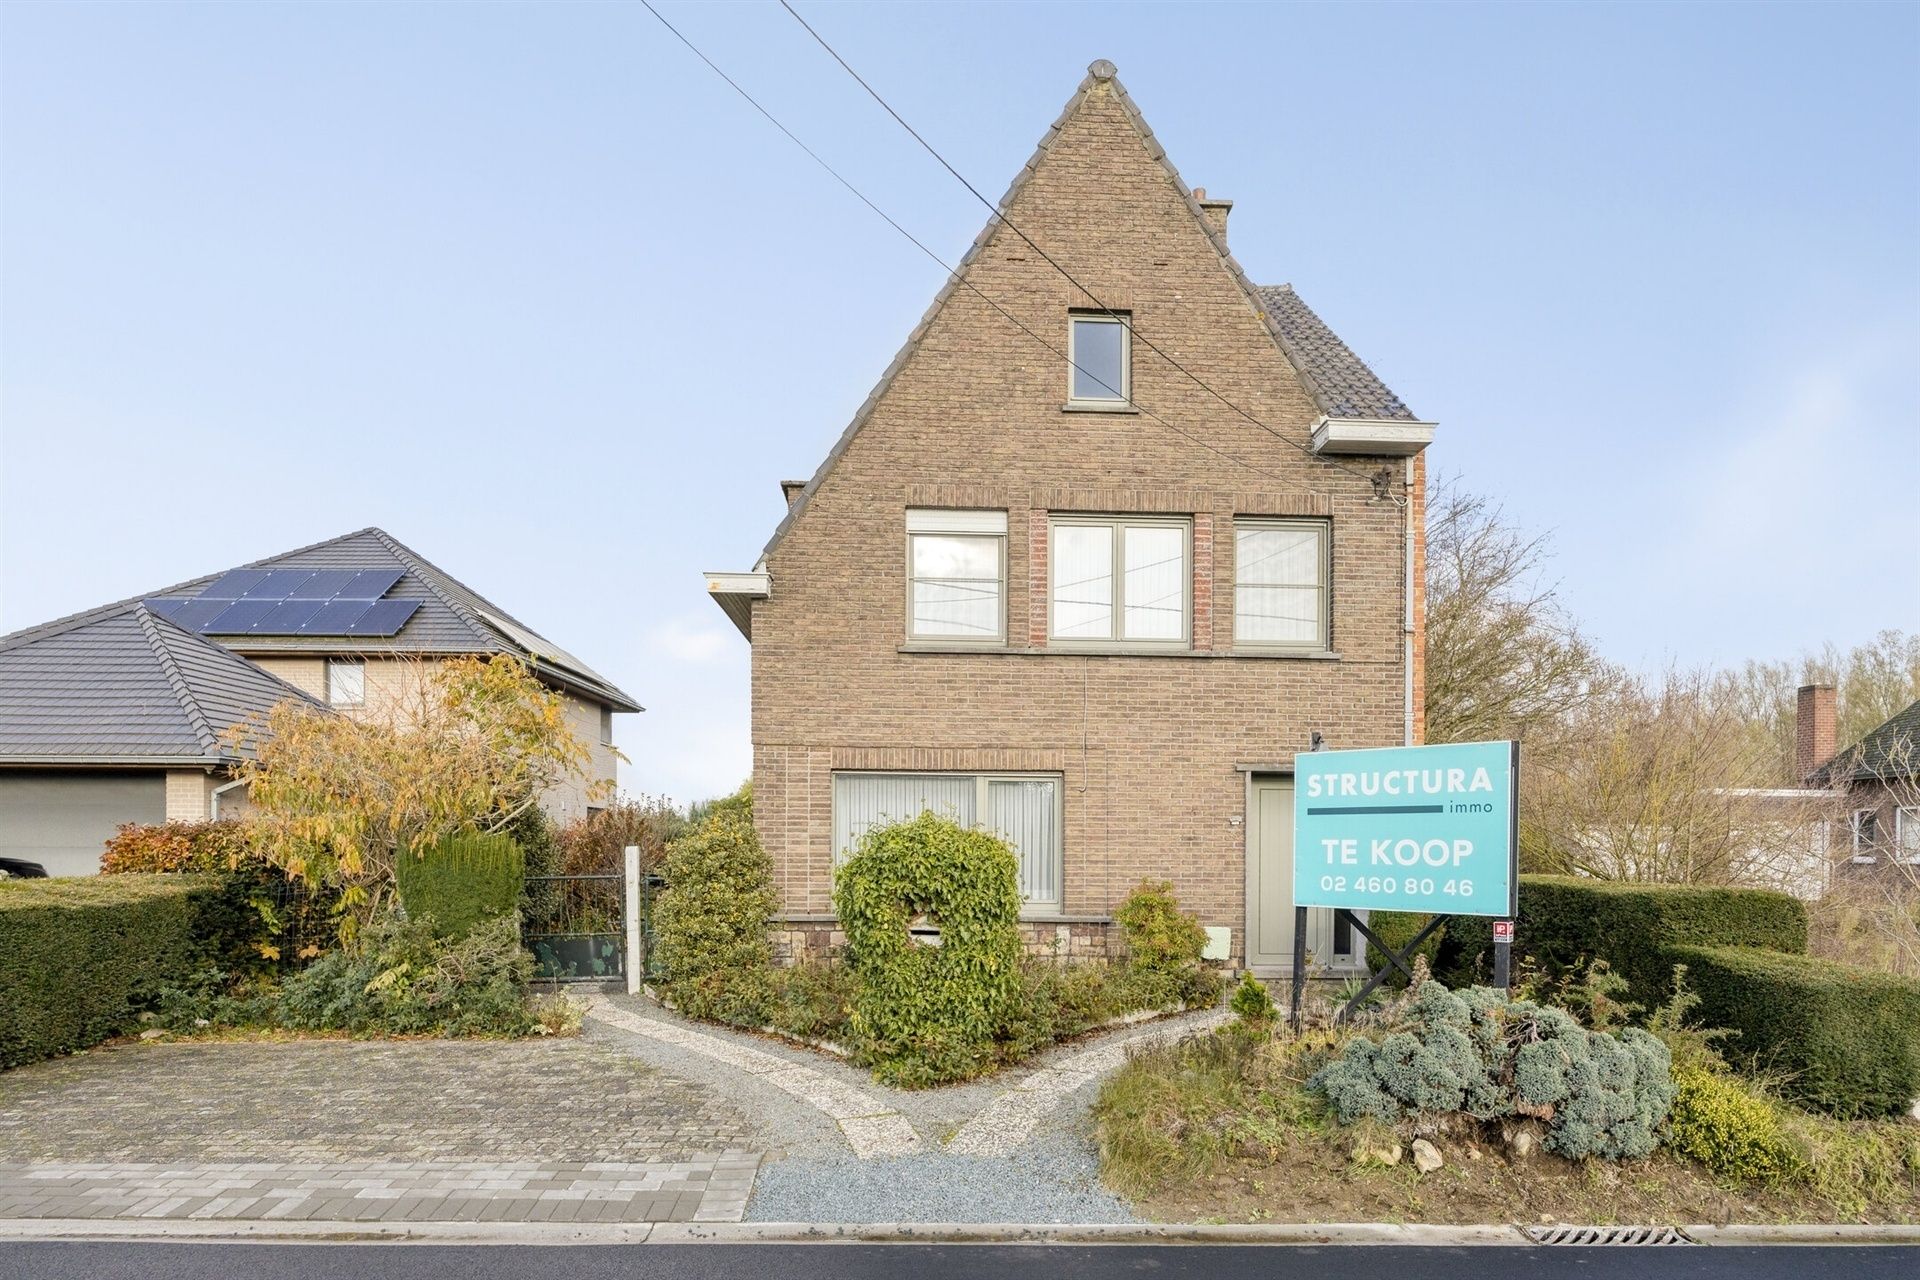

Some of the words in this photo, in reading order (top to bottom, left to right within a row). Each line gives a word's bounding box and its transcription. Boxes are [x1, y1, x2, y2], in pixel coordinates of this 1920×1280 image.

[1307, 767, 1493, 797] STRUCTURA
[1449, 800, 1493, 813] immo
[1321, 839, 1358, 865] TE
[1371, 839, 1473, 866] KOOP
[1320, 875, 1346, 892] 02
[1354, 876, 1396, 894] 460
[1404, 878, 1434, 895] 80
[1443, 879, 1473, 896] 46
